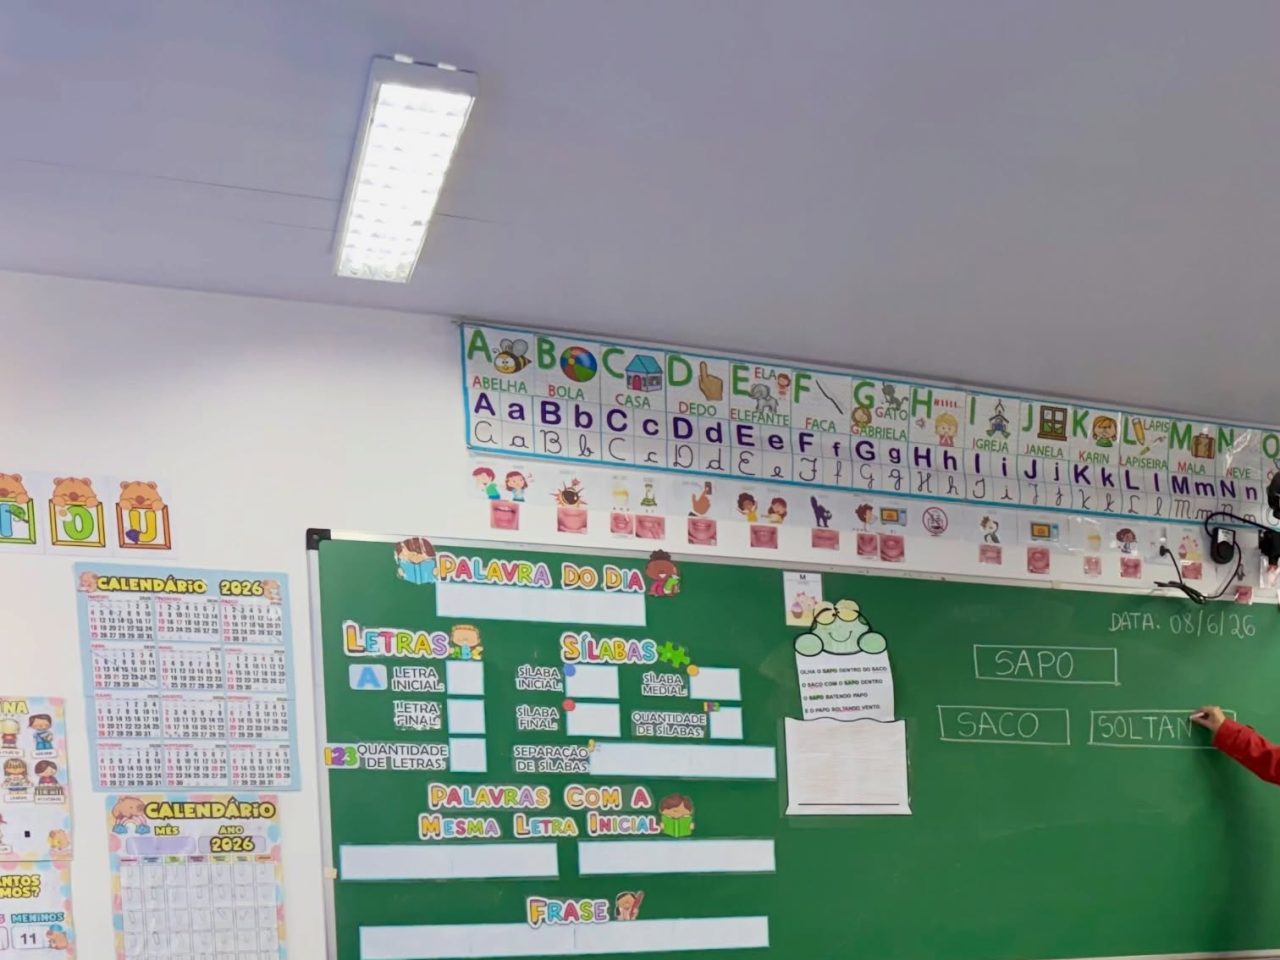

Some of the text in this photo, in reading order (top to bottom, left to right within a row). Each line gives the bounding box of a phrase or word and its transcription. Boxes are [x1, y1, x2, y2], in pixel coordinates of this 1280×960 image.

[467, 329, 492, 363] A
[537, 337, 557, 369] B
[602, 348, 624, 379] C
[668, 355, 693, 386] D
[733, 364, 751, 395] E
[754, 367, 777, 381] ELA
[473, 376, 528, 393] ABELHA
[548, 384, 585, 400] BOLA
[794, 373, 812, 403] F
[615, 393, 650, 408] CASA
[854, 381, 875, 409] G
[912, 388, 932, 418] H
[679, 401, 717, 417] DEDO
[730, 408, 789, 426] ELEFANTE
[875, 406, 908, 421] GATO
[805, 417, 836, 432] FACA
[1022, 404, 1033, 432] J
[1072, 409, 1089, 438] K
[851, 424, 907, 441] GABRIELA
[1123, 416, 1136, 445] L
[1170, 421, 1192, 450] M
[972, 437, 1009, 453] IGREJA
[1218, 428, 1234, 453] N
[1263, 434, 1280, 459] O
[1025, 444, 1064, 458] JANELA
[1079, 450, 1110, 464] KARIN
[1119, 456, 1168, 470] LAPISEIRA
[1178, 461, 1206, 475] MALA
[1225, 467, 1251, 479] NEVE
[439, 554, 644, 591] PALAVRA DO DIA
[219, 579, 264, 596] 2026
[346, 624, 448, 656] LETRAS
[563, 634, 656, 662] SÍLABAS
[518, 665, 559, 678] SÍLABA
[995, 650, 1074, 679] SAPO
[357, 666, 381, 688] A
[395, 668, 437, 679] LETRA
[643, 672, 683, 684] SÍLABA
[397, 702, 438, 713] LETRA
[518, 705, 558, 718] SÍLABA
[633, 712, 706, 724] QUANTIDADE
[958, 712, 1193, 741] SACO SOLTAN
[638, 725, 652, 735] DE
[324, 744, 448, 767] 123 QUANTIDADE
[515, 745, 588, 759] SEPARAÇÃO
[367, 758, 386, 769] DE
[518, 761, 533, 771] DE
[431, 784, 650, 808] PALAVRAS COM A
[154, 823, 244, 836] MÊS ANO
[421, 812, 660, 838] MESMA LETRA INICIAL
[210, 836, 255, 852] 2026
[11, 912, 64, 924] MENINOS
[529, 898, 608, 926] FRASE
[20, 933, 37, 945] 11
